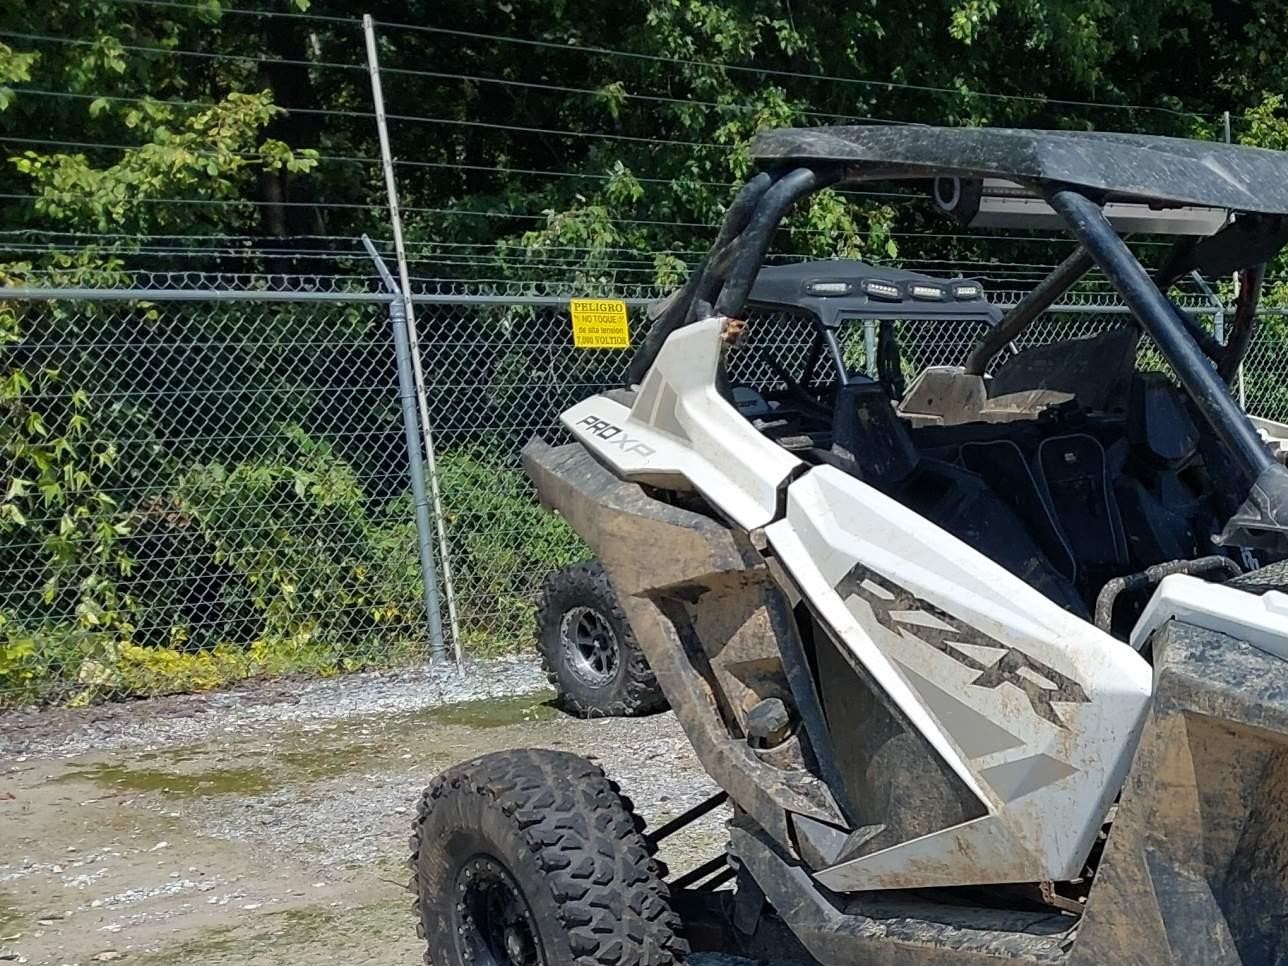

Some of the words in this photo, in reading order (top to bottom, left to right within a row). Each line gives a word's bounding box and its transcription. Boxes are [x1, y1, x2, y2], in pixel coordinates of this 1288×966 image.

[573, 302, 623, 313] PELIGRO
[582, 315, 593, 323] NO
[594, 315, 617, 324] TOQUE
[595, 336, 627, 345] VOLTIOS
[575, 415, 624, 440] PRO
[609, 434, 657, 457] XP
[834, 561, 1092, 732] RZR
